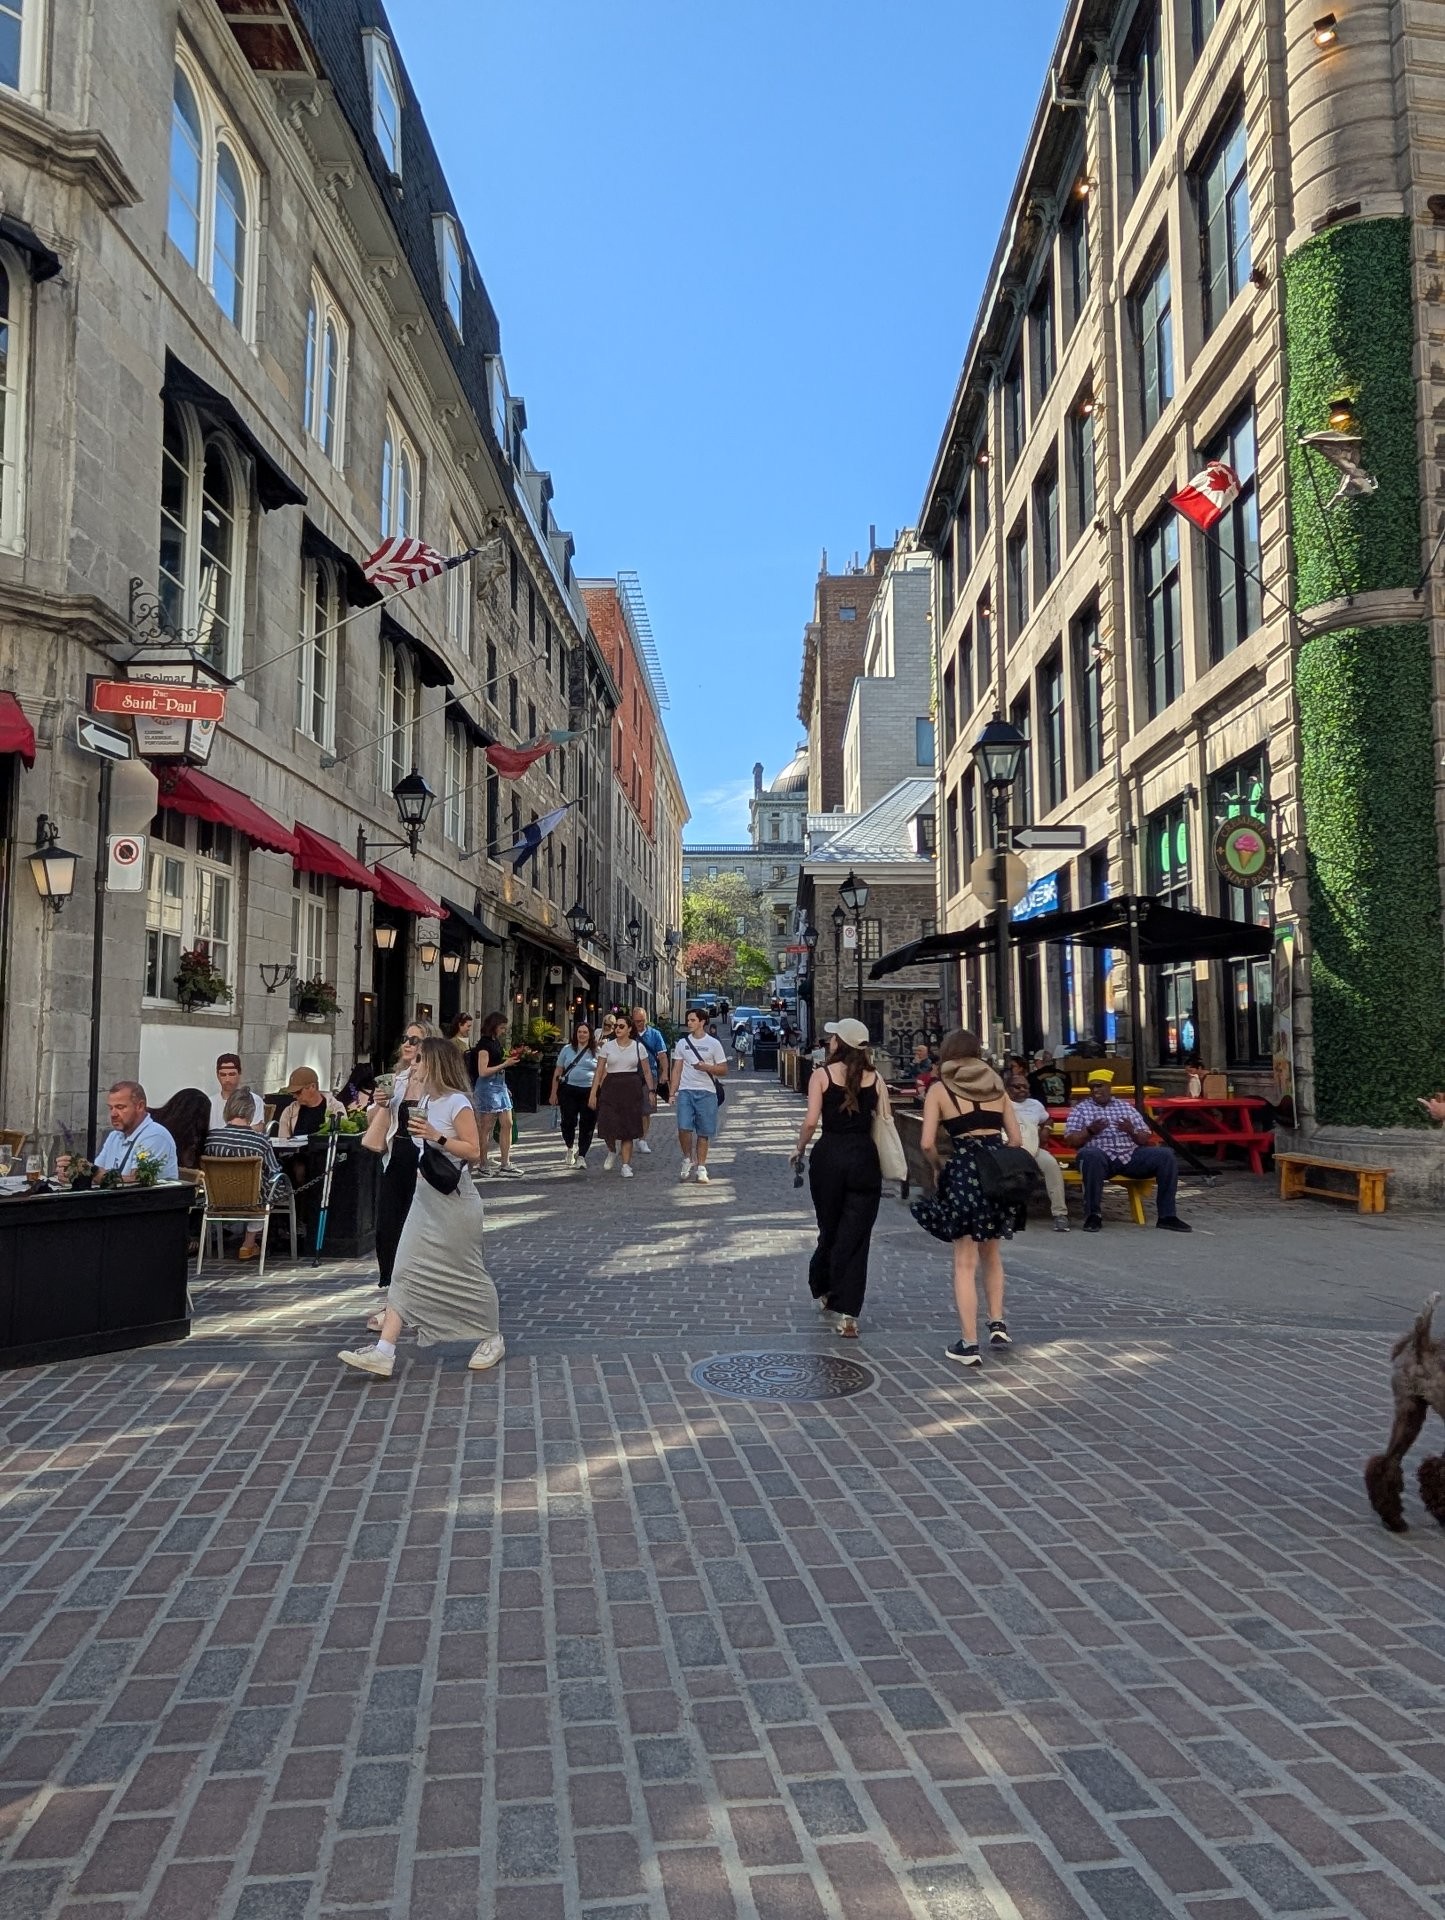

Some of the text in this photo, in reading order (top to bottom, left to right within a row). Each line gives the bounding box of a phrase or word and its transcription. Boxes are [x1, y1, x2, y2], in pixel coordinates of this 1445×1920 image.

[152, 690, 169, 698] Rue
[121, 695, 197, 713] Saint-Paul
[1221, 864, 1273, 886] SAINT PAUL
